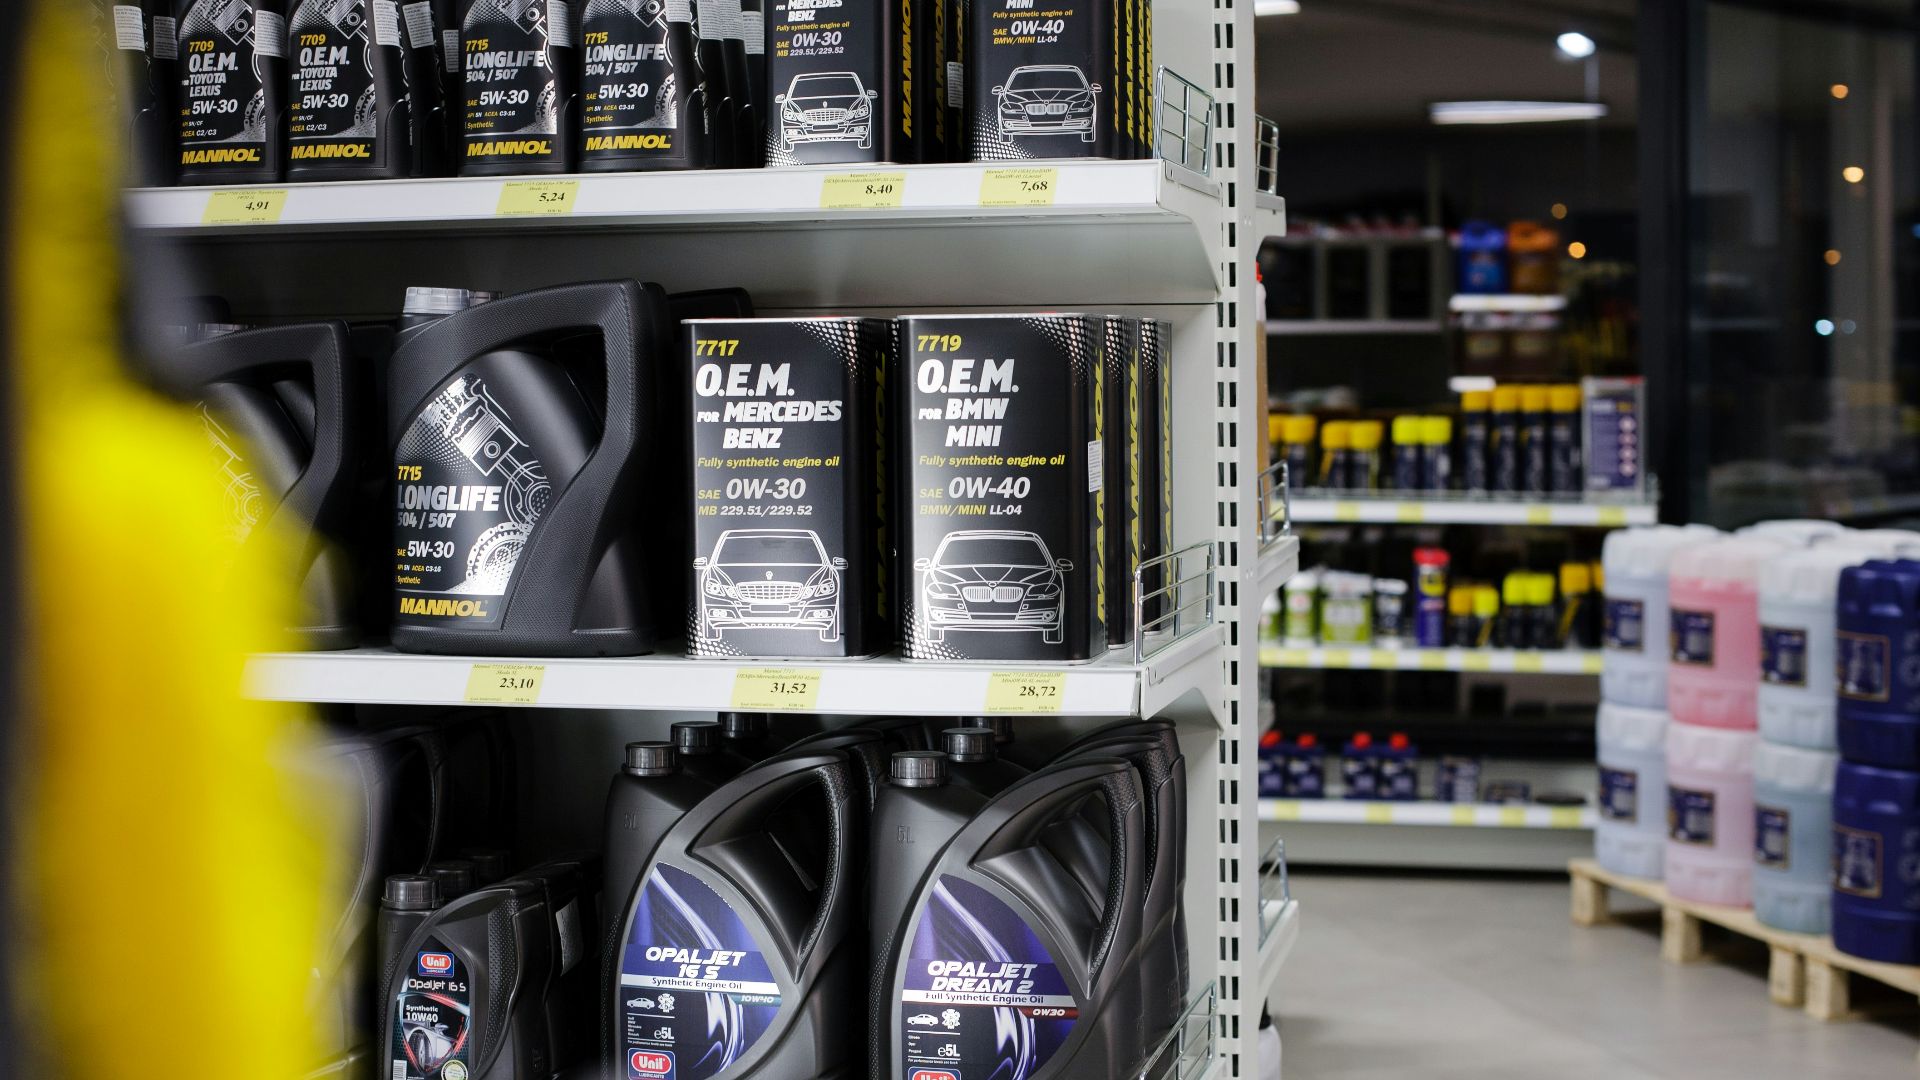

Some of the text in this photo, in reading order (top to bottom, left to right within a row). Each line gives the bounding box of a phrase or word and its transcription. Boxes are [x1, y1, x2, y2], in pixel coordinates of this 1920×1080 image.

[788, 10, 815, 22] BENZ
[1011, 20, 1065, 35] 0W-40
[300, 34, 326, 46] 7709
[466, 39, 489, 51] 7715
[585, 32, 608, 44] 7715
[776, 32, 842, 49] SAE 0W-30
[993, 35, 1058, 45] BMW/MINI LL-04
[189, 41, 215, 53] 7709
[585, 43, 665, 64] LONGLIFE
[189, 53, 238, 72] O.E.M.
[300, 46, 350, 66] O.E.M.
[466, 50, 545, 70] LONGLIFE
[300, 67, 338, 79] TOYOTA
[466, 70, 486, 82] 504
[495, 69, 518, 81] 507
[585, 64, 606, 76] 504
[614, 62, 638, 75] 507
[189, 73, 227, 85] TOYOTA
[300, 79, 332, 92] LEXUS
[189, 85, 221, 98] LEXUS
[479, 90, 530, 106] 5W-30
[599, 83, 649, 100] 5W-30
[192, 100, 238, 115] 5W-30
[291, 94, 349, 111] SAE 5W-30
[467, 121, 495, 130] Synthetic
[586, 115, 614, 124] Synthetic
[196, 129, 217, 137] C2/C3
[306, 124, 327, 132] C2/C3
[467, 140, 552, 157] MANNOL
[586, 135, 672, 151] MANNOL
[181, 149, 260, 165] MANNOL
[291, 144, 371, 160] MANNOL
[865, 184, 893, 195] 8,40
[1021, 181, 1048, 192] 7,68
[696, 340, 739, 357] 7717
[917, 335, 962, 352] 7719
[695, 363, 795, 397] O.E.M.
[917, 358, 1020, 394] O.E.M.
[697, 400, 843, 423] FOR MERCEDES
[918, 398, 1010, 420] FOR BMW
[722, 428, 784, 449] BENZ
[945, 425, 1003, 447] MINI
[698, 456, 840, 469] Fully synthetic engine oil
[919, 454, 1066, 469] Fully synthetic engine oil
[398, 466, 422, 481] 7715
[698, 478, 807, 500] SAE 0W-30
[919, 476, 1031, 499] SAE 0W-40
[397, 485, 503, 512] LONGLIFE
[698, 505, 813, 518] MB 229.51/229.52
[920, 504, 1023, 517] BMW/MINI LL-04
[398, 512, 417, 528] 504
[428, 513, 457, 528] 507
[397, 541, 455, 559] SAE 5W-30
[397, 575, 421, 585] Synthetic
[400, 598, 487, 617] MANNOL
[500, 678, 534, 689] 23,10
[770, 682, 807, 695] 31,52
[1019, 686, 1056, 698] 28,72
[426, 956, 446, 968] Unil
[645, 947, 747, 966] OPALJET
[678, 965, 721, 980] 16 S
[927, 960, 1038, 980] OPALJET
[448, 982, 458, 992] 16
[459, 982, 467, 992] S
[652, 977, 742, 990] Synthetic Engine Oil
[931, 977, 1036, 994] DREAM 2
[926, 992, 1044, 1005] Full Synthetic Engine Oil
[406, 1005, 439, 1013] Synthetic
[406, 1012, 439, 1023] 10W40
[639, 1056, 663, 1070] Unil
